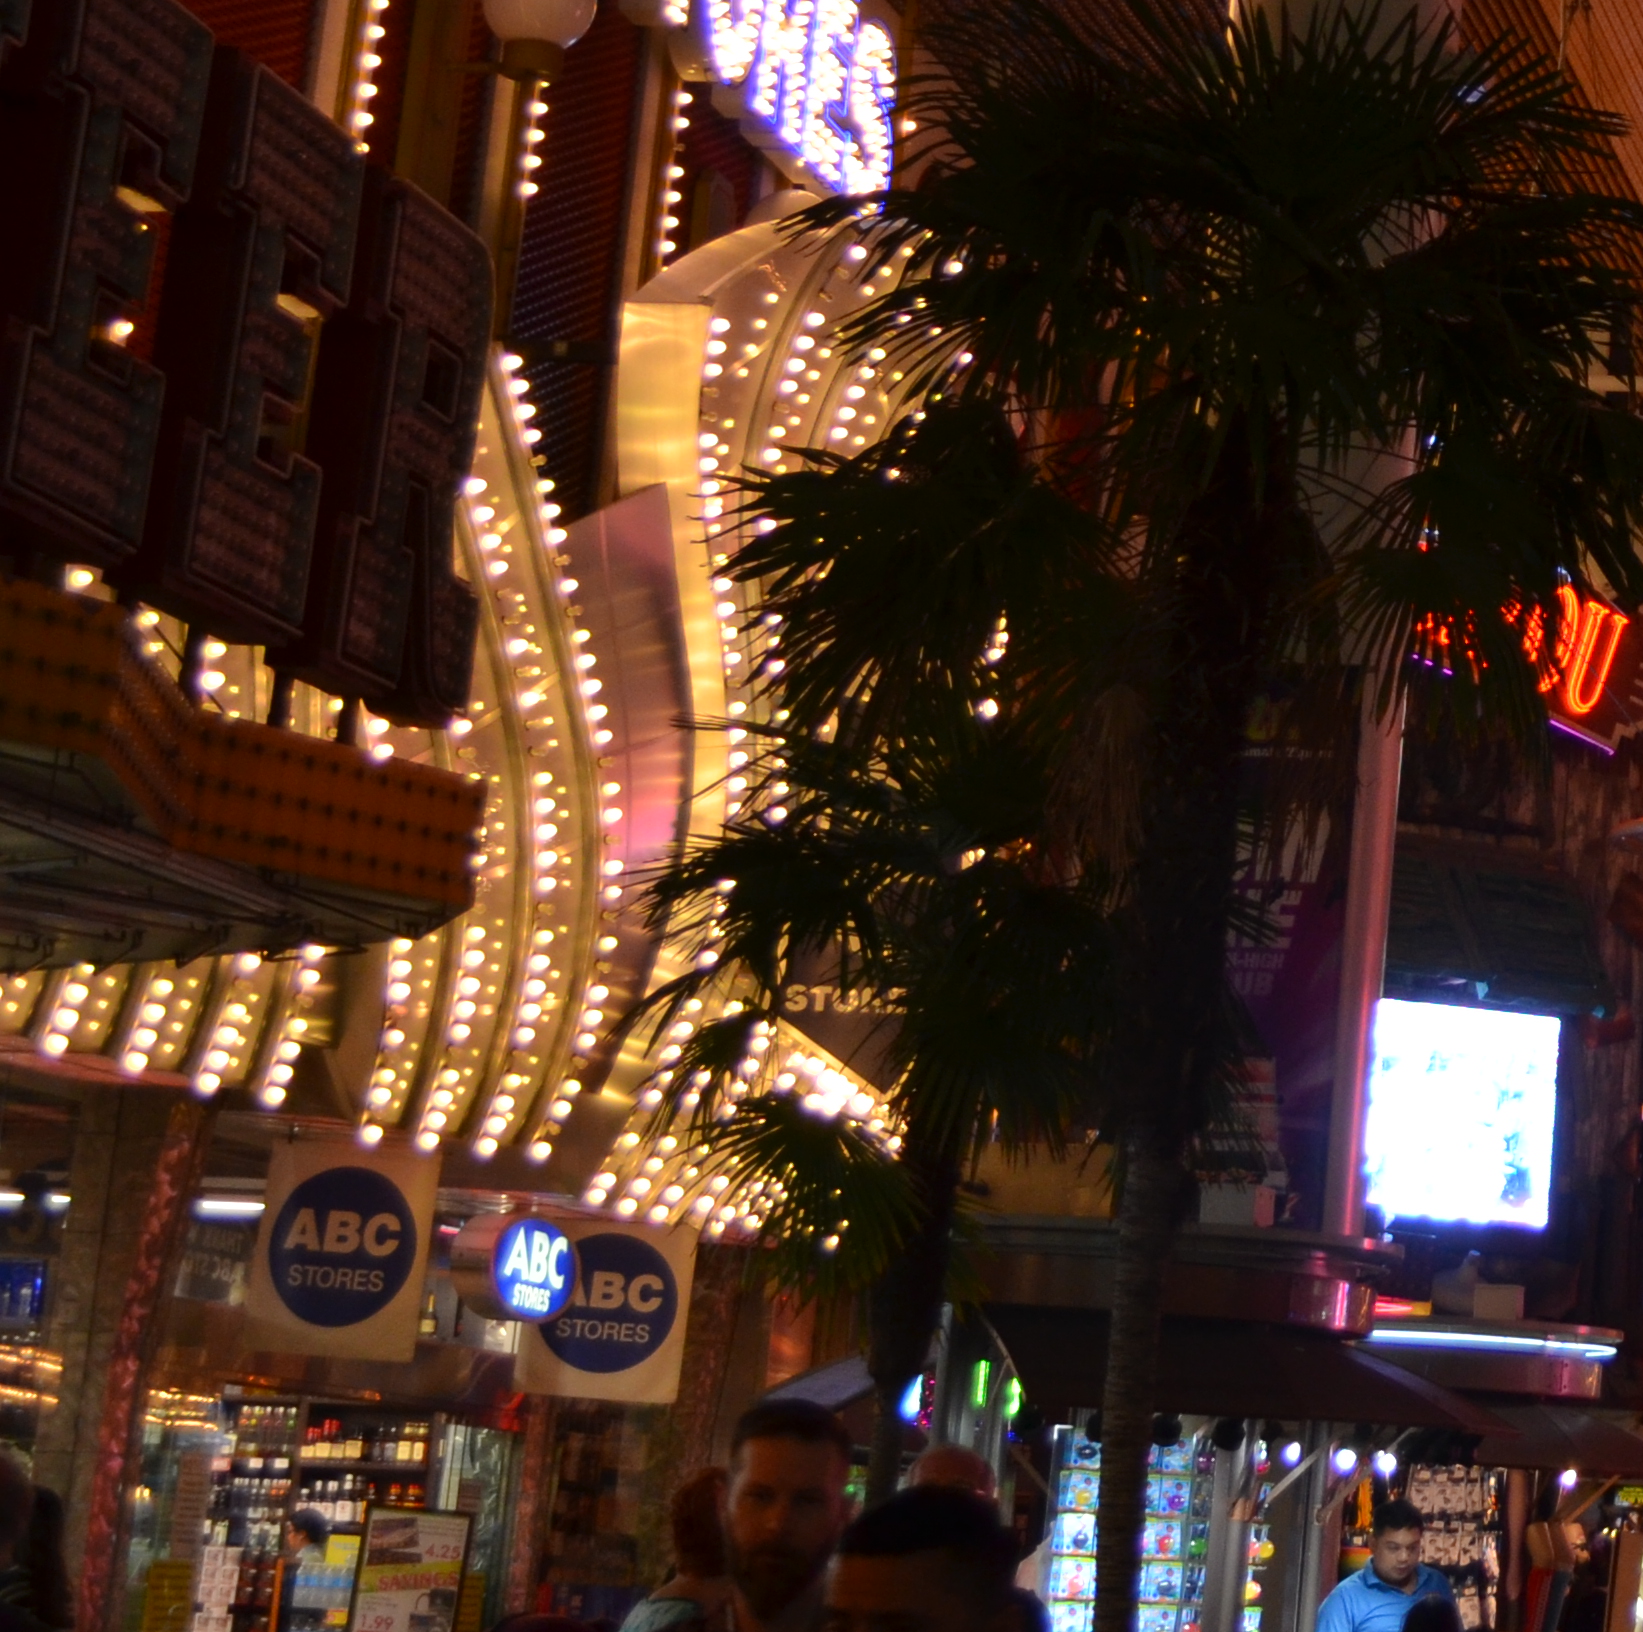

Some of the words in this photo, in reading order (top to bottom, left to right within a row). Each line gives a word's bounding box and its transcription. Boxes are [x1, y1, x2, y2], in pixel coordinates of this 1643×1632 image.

[284, 1206, 403, 1257] ABC
[504, 1225, 569, 1290] ABC
[286, 1264, 385, 1293] STORES
[512, 1283, 551, 1313] STORES
[556, 1318, 651, 1343] STORES
